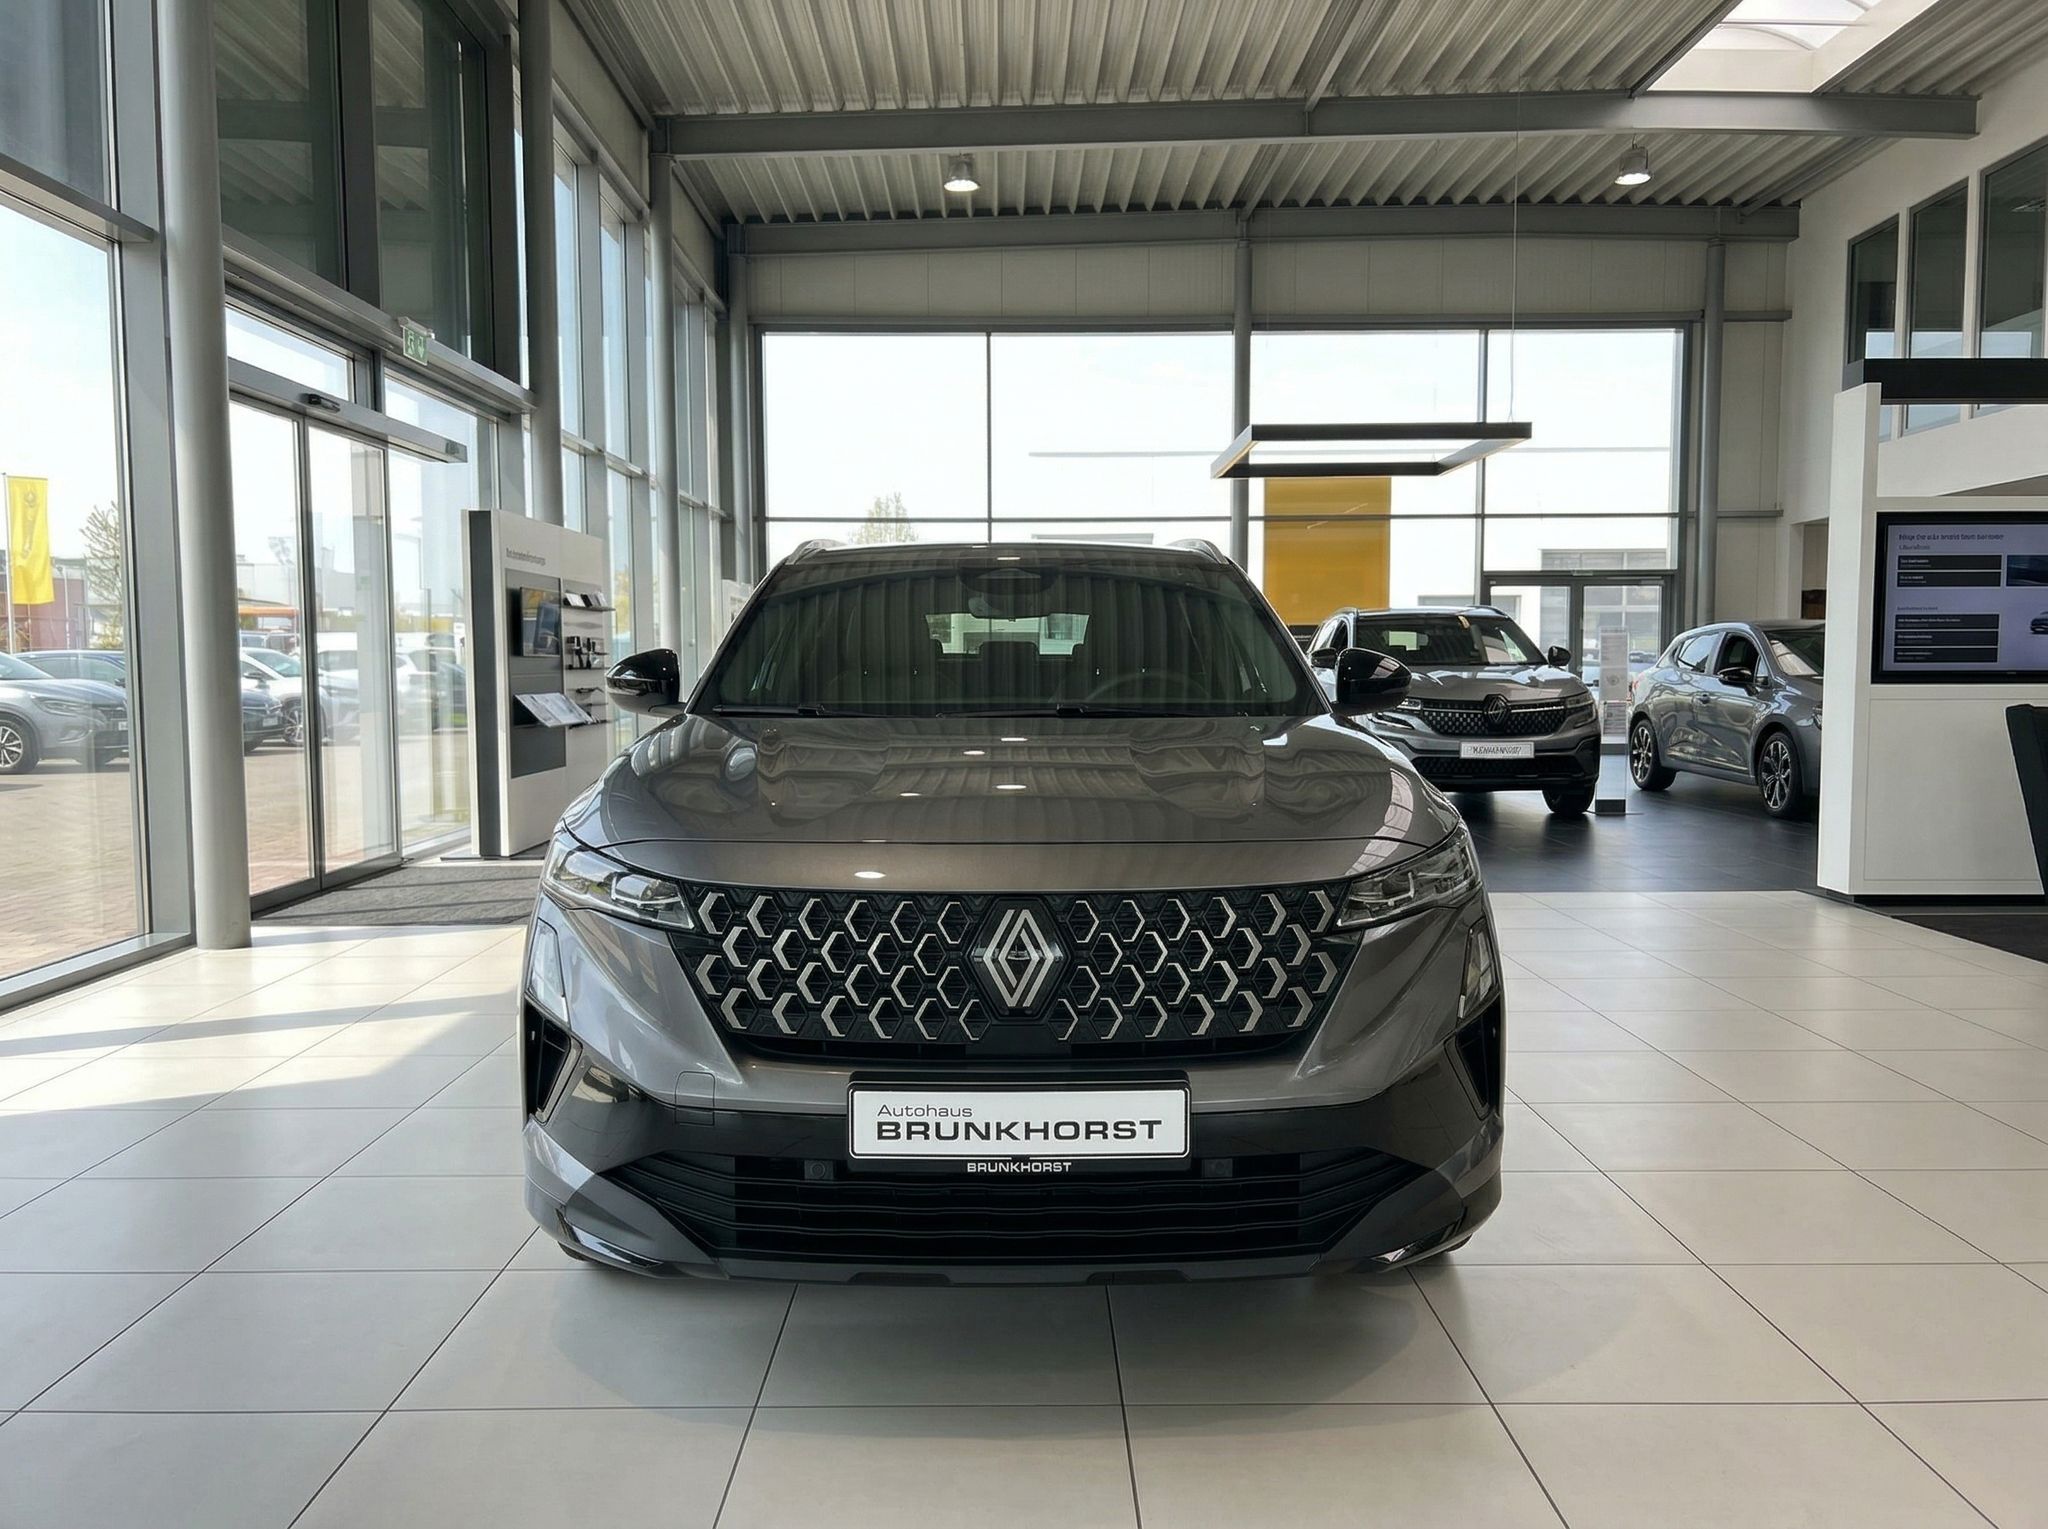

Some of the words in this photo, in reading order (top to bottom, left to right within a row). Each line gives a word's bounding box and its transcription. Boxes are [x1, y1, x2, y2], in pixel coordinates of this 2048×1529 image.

[877, 1104, 973, 1118] Autohaus
[877, 1120, 1162, 1141] BRUNKHORST
[966, 1162, 1072, 1173] BRUNKHORST
